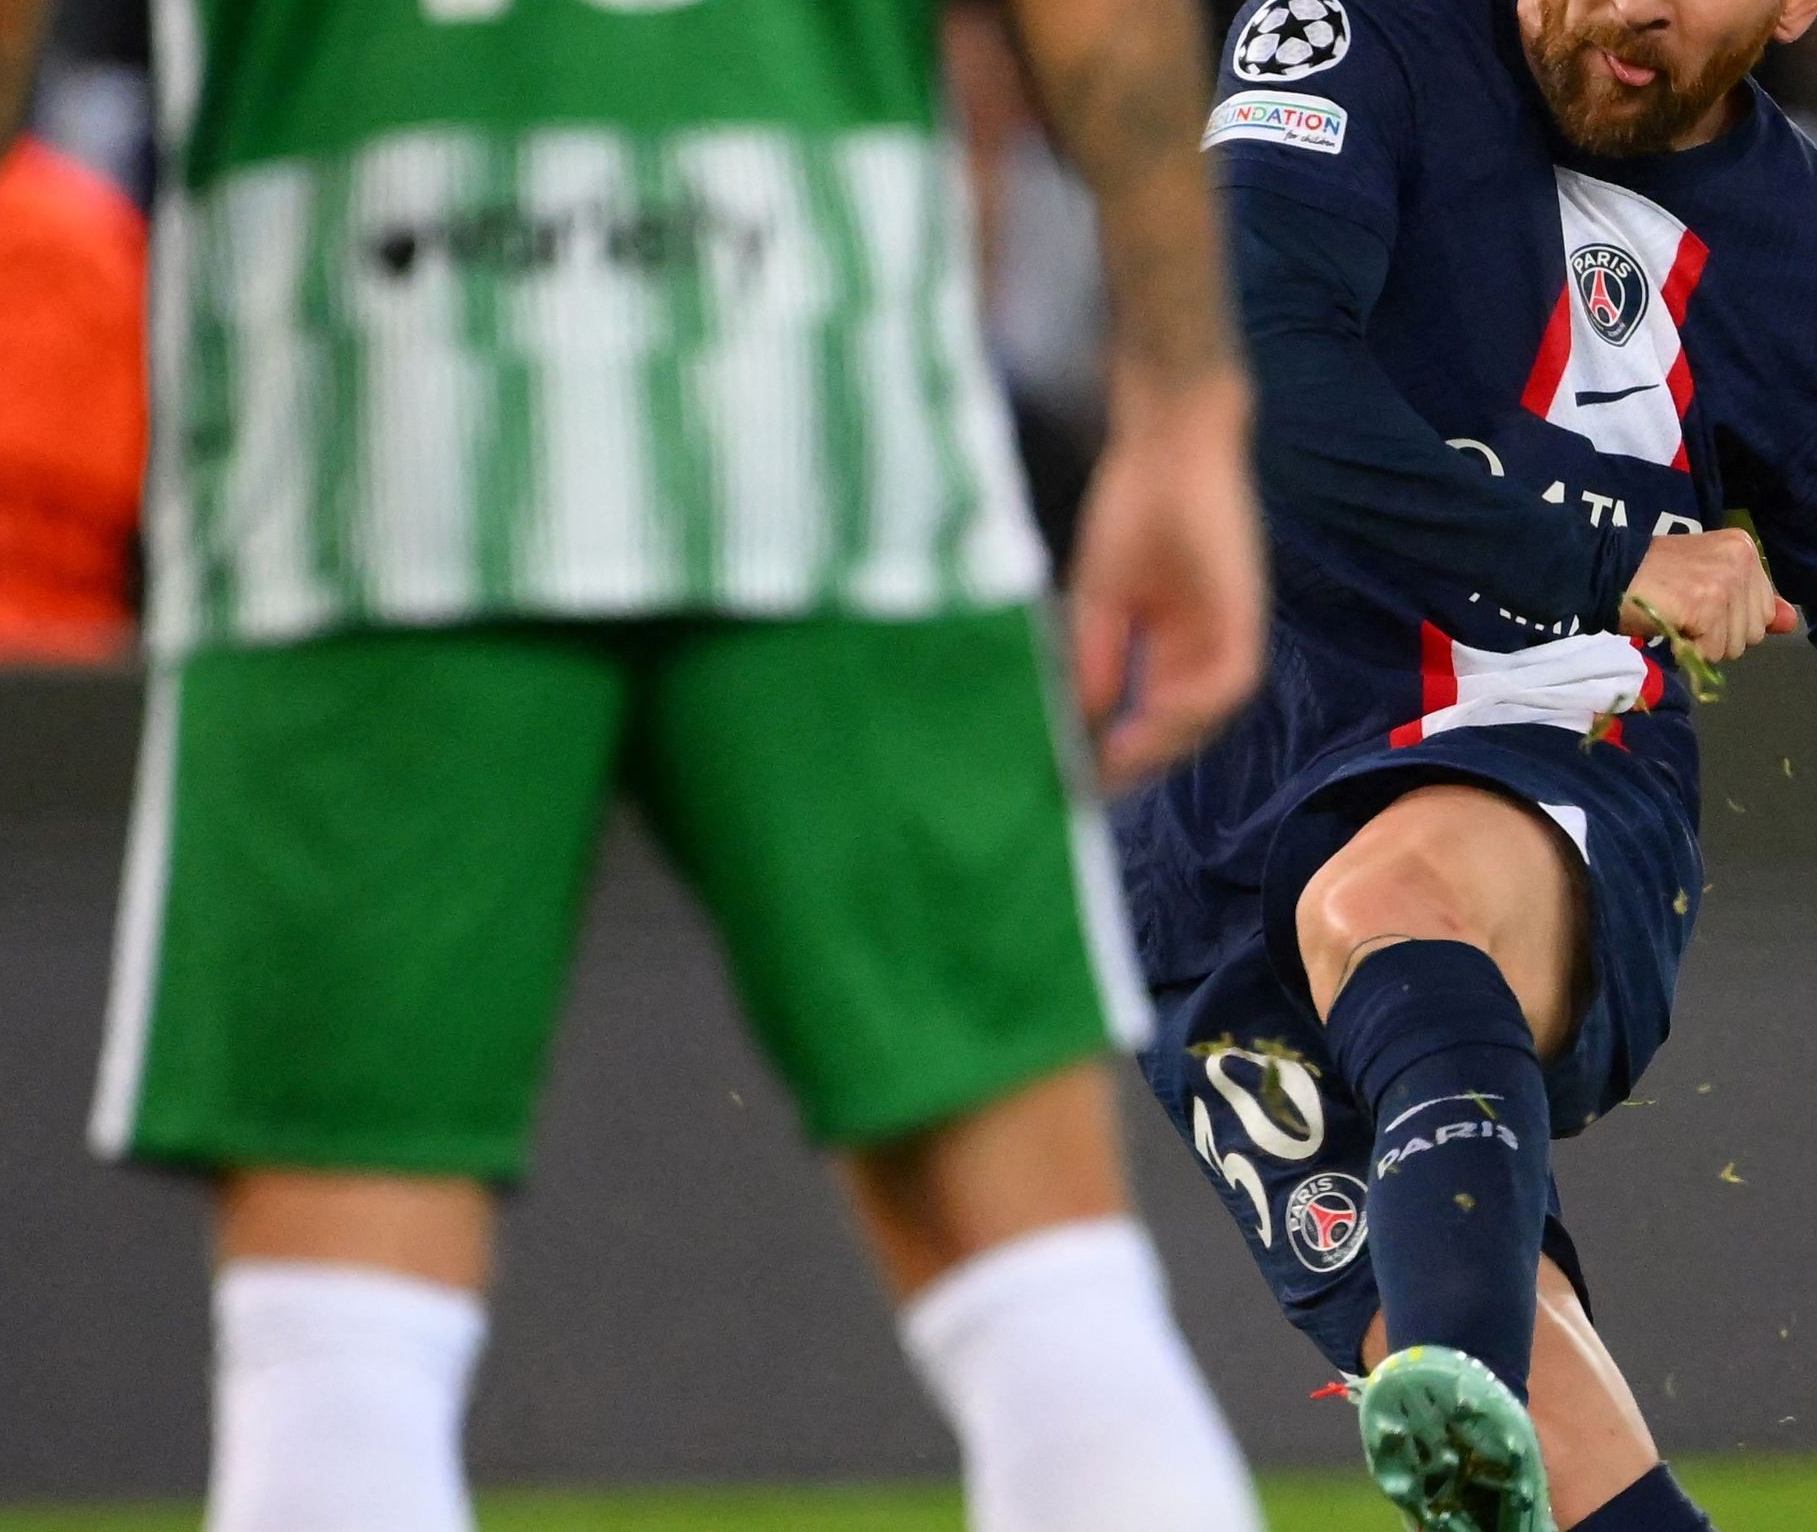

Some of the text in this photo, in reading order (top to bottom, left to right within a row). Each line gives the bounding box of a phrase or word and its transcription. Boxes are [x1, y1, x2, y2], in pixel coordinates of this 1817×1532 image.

[1207, 106, 1340, 136] UNDATION
[1573, 251, 1632, 278] PARIS
[1377, 1120, 1519, 1180] PARIS
[1289, 1177, 1333, 1232] PARIS
